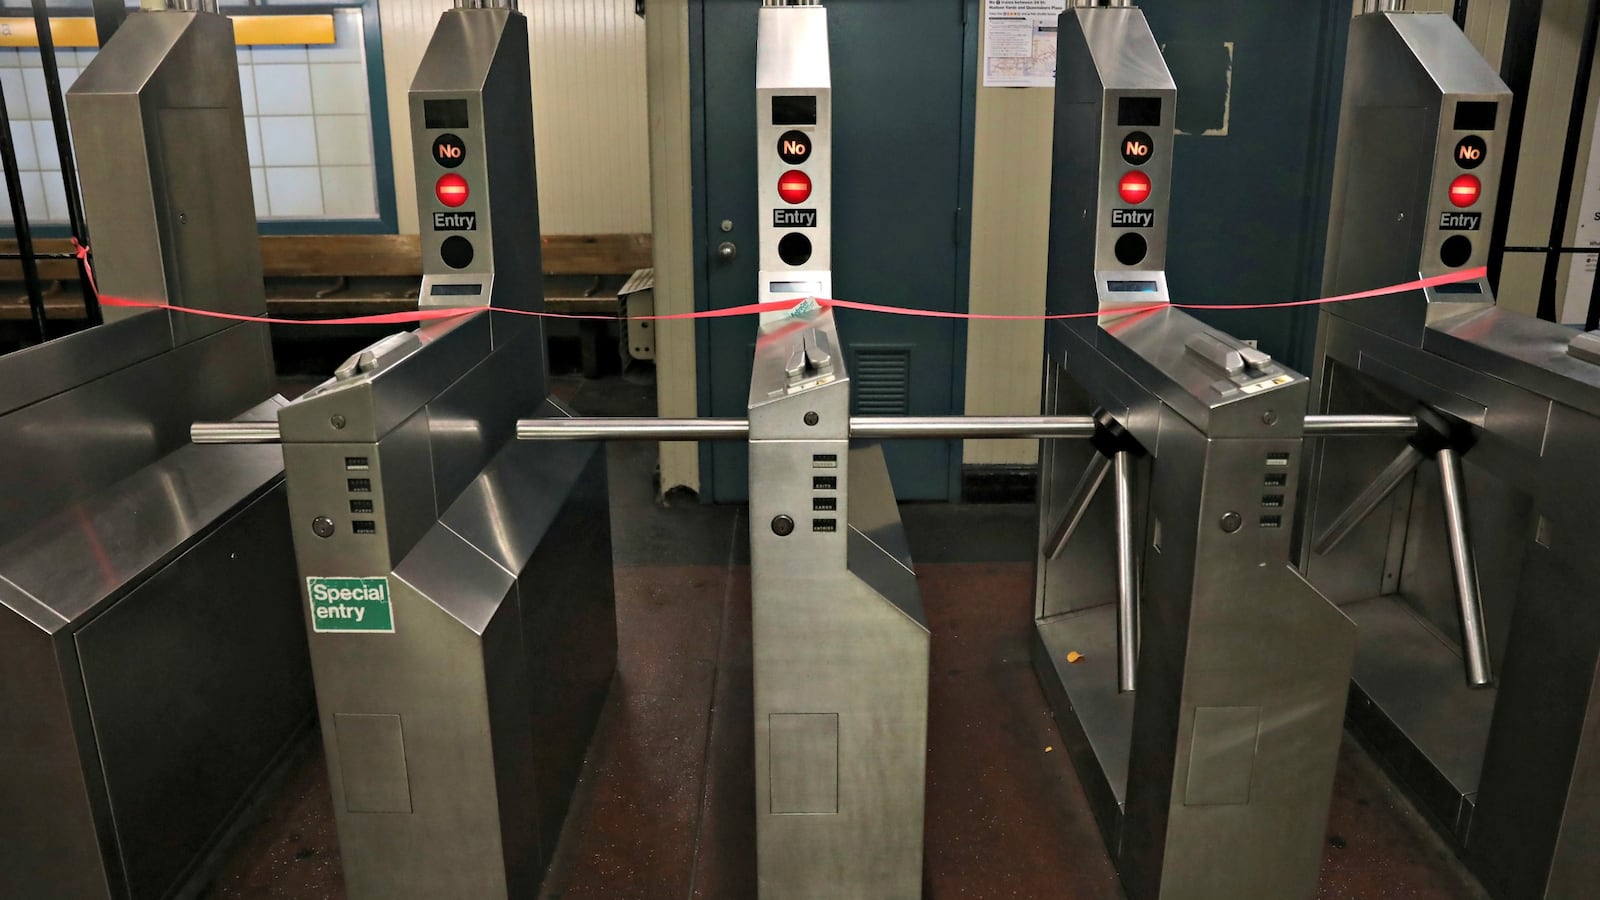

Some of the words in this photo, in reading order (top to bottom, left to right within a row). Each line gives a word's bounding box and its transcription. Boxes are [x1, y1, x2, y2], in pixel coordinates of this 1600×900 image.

[439, 144, 461, 158] No
[783, 140, 806, 155] No
[1126, 141, 1148, 156] No
[1459, 145, 1480, 160] No
[434, 213, 474, 230] Entry
[774, 210, 815, 226] Entry
[1112, 210, 1152, 226] Entry
[1440, 213, 1479, 230] Entry
[314, 584, 385, 603] Special
[316, 603, 365, 622] entry
